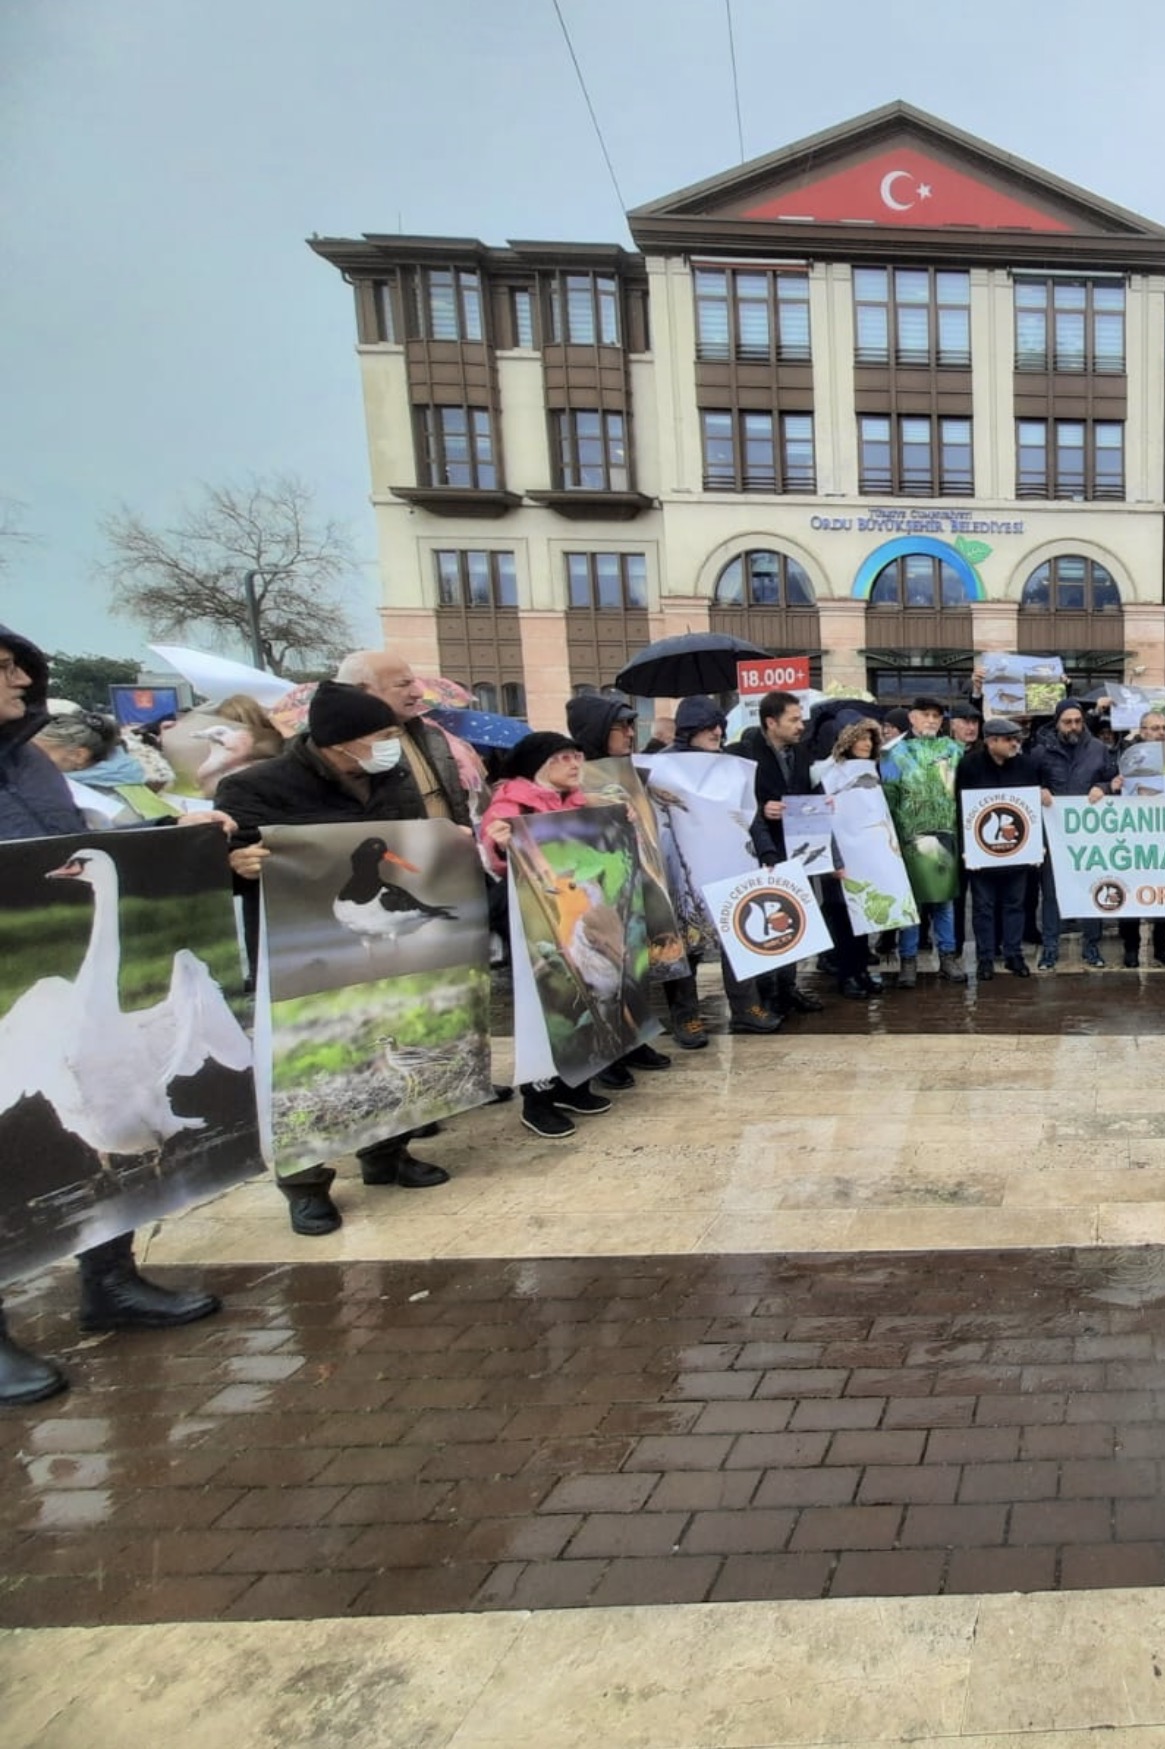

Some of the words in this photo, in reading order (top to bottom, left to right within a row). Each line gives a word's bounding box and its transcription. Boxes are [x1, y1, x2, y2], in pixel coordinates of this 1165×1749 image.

[810, 515, 852, 531] ORDU
[858, 517, 944, 535] BÜYÜKŞEHİR
[951, 518, 1024, 535] BELEDİYESİ
[741, 666, 806, 688] 18.000+
[719, 901, 733, 933] ORDU
